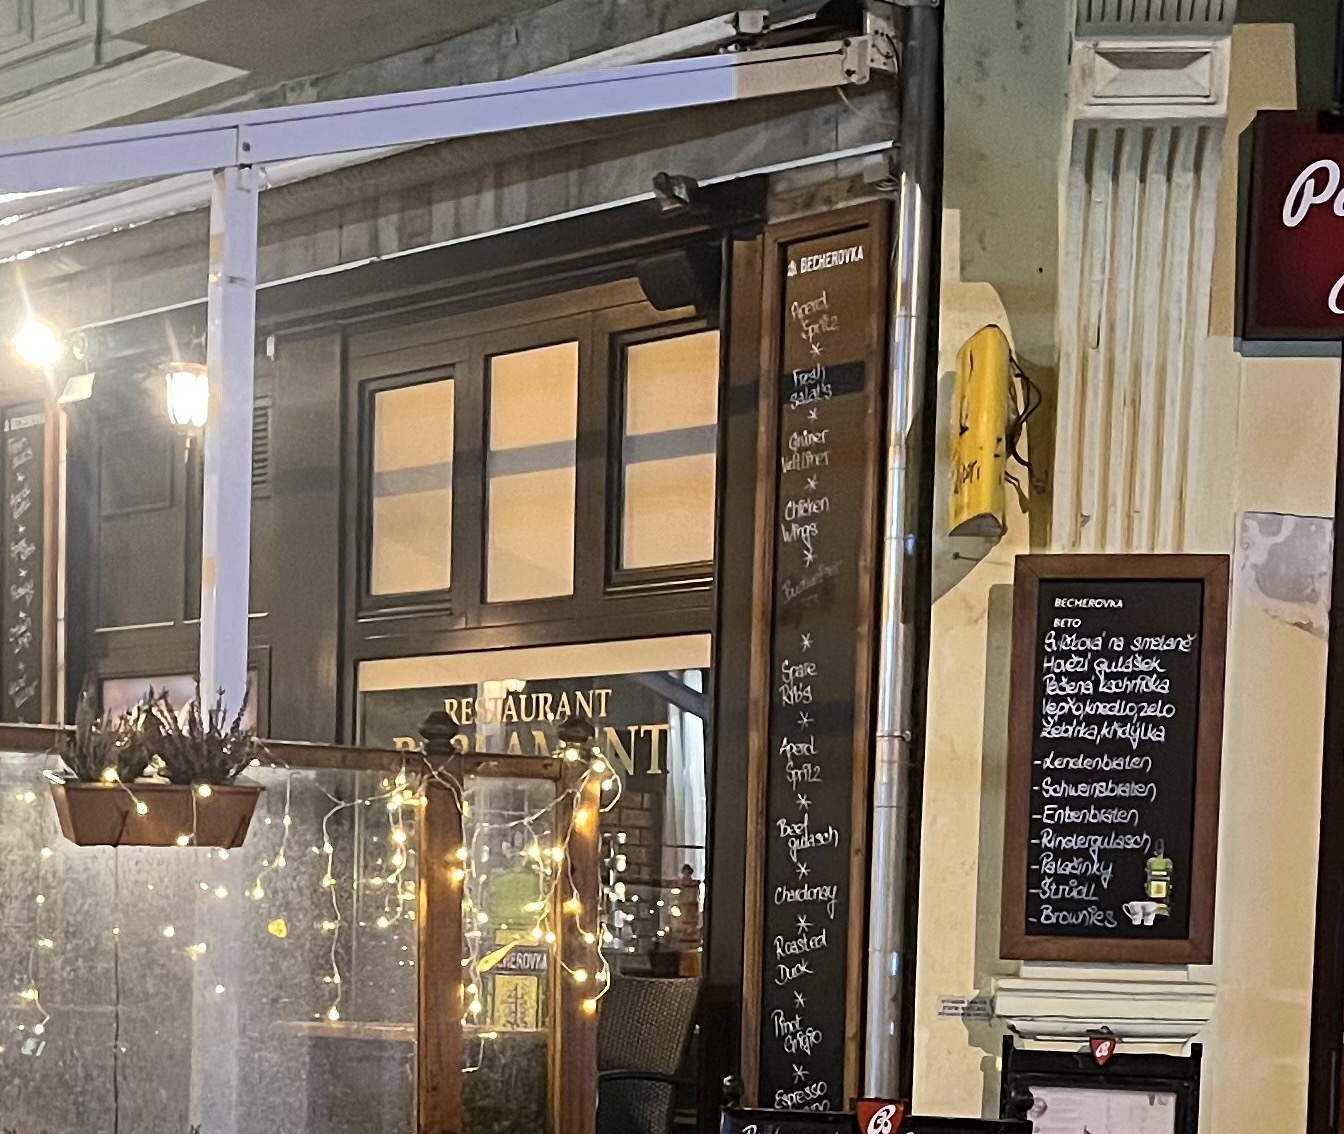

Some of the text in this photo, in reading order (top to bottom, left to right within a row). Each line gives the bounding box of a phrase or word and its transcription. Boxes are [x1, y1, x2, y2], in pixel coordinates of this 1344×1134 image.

[800, 246, 864, 273] BECHEROVKA
[785, 497, 829, 521] Chicken
[781, 522, 818, 555] Wings
[1054, 597, 1124, 609] BECHEROVKA
[1108, 636, 1125, 651] na
[781, 660, 818, 686] Spare
[443, 688, 612, 727] RESTAURANT
[788, 826, 839, 863] gulasch
[773, 928, 828, 960] Roasted
[775, 958, 814, 985] Duck
[771, 1009, 803, 1038] Pinot
